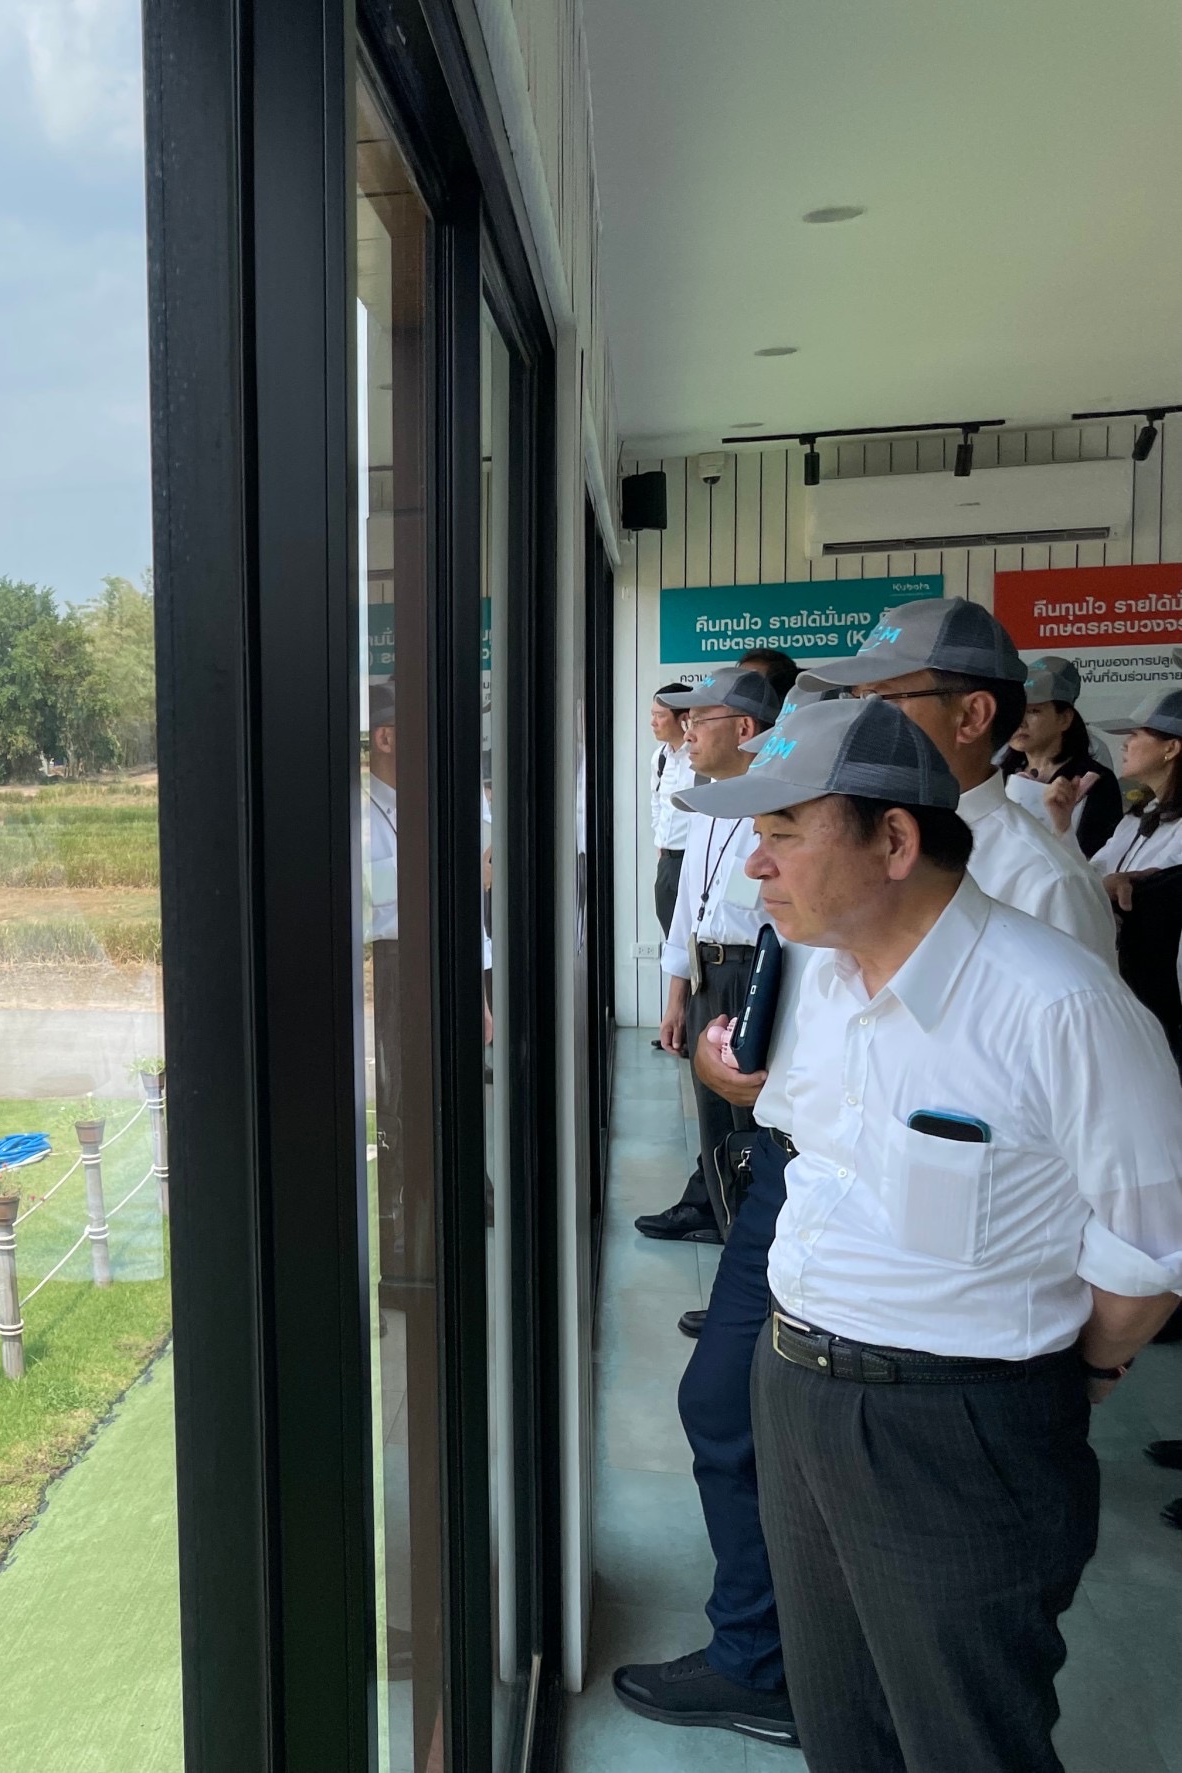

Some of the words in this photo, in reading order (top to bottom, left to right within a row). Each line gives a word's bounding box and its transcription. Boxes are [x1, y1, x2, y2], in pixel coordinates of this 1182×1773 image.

[1033, 597, 1106, 620] คืนทุนไว
[696, 613, 762, 635] คืนทุนไว
[769, 606, 871, 629] รายได้มั่นคง
[701, 632, 838, 651] เกษตรครบวงจร
